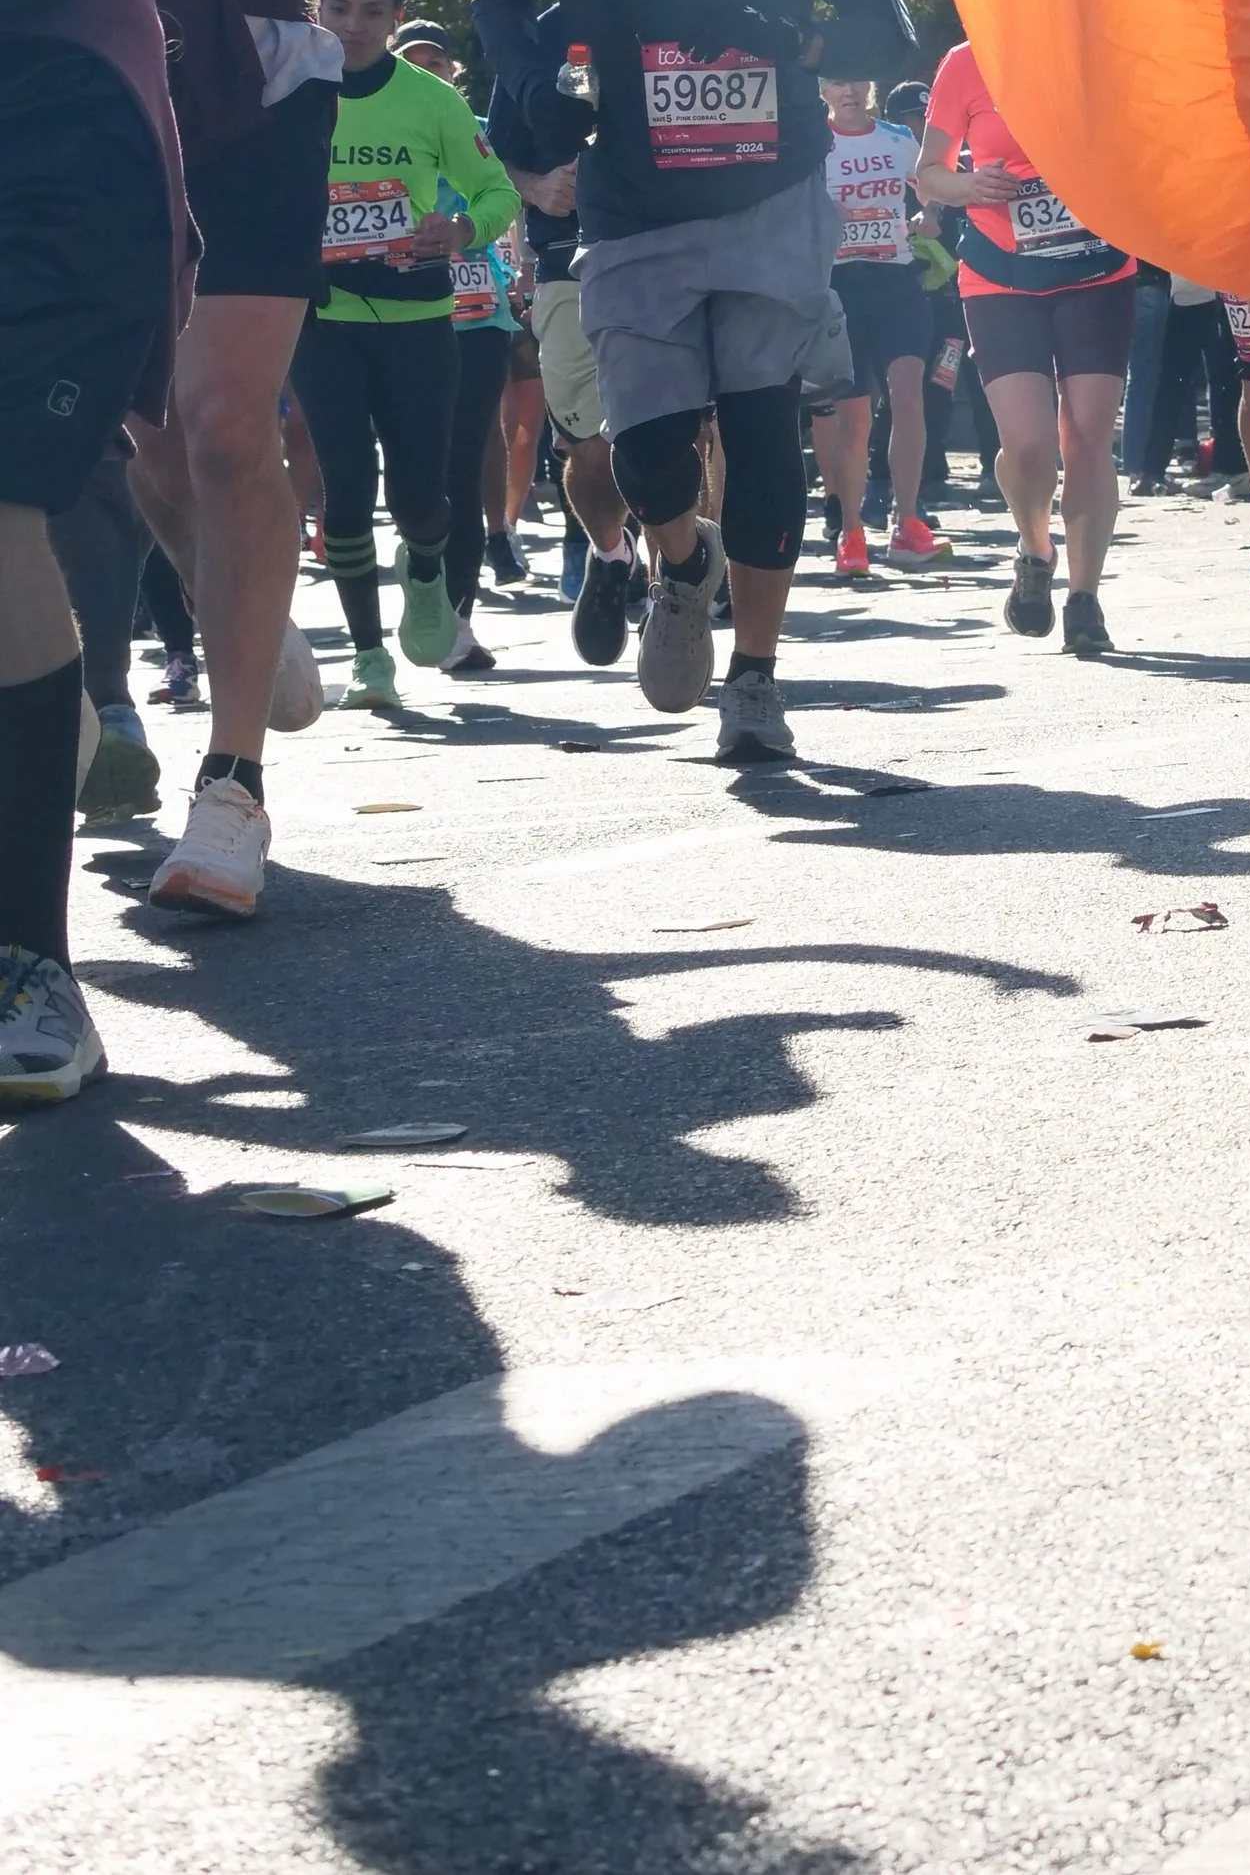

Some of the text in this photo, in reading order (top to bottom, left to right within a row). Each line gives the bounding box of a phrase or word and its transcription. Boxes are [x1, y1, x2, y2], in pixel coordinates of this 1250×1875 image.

[653, 71, 769, 113] 59687
[666, 114, 673, 123] 5
[676, 114, 692, 122] PINK
[692, 114, 718, 122] CORRAL
[718, 112, 727, 121] C
[331, 145, 413, 166] LISSA
[735, 142, 765, 153] 2024
[840, 154, 896, 176] SUSE
